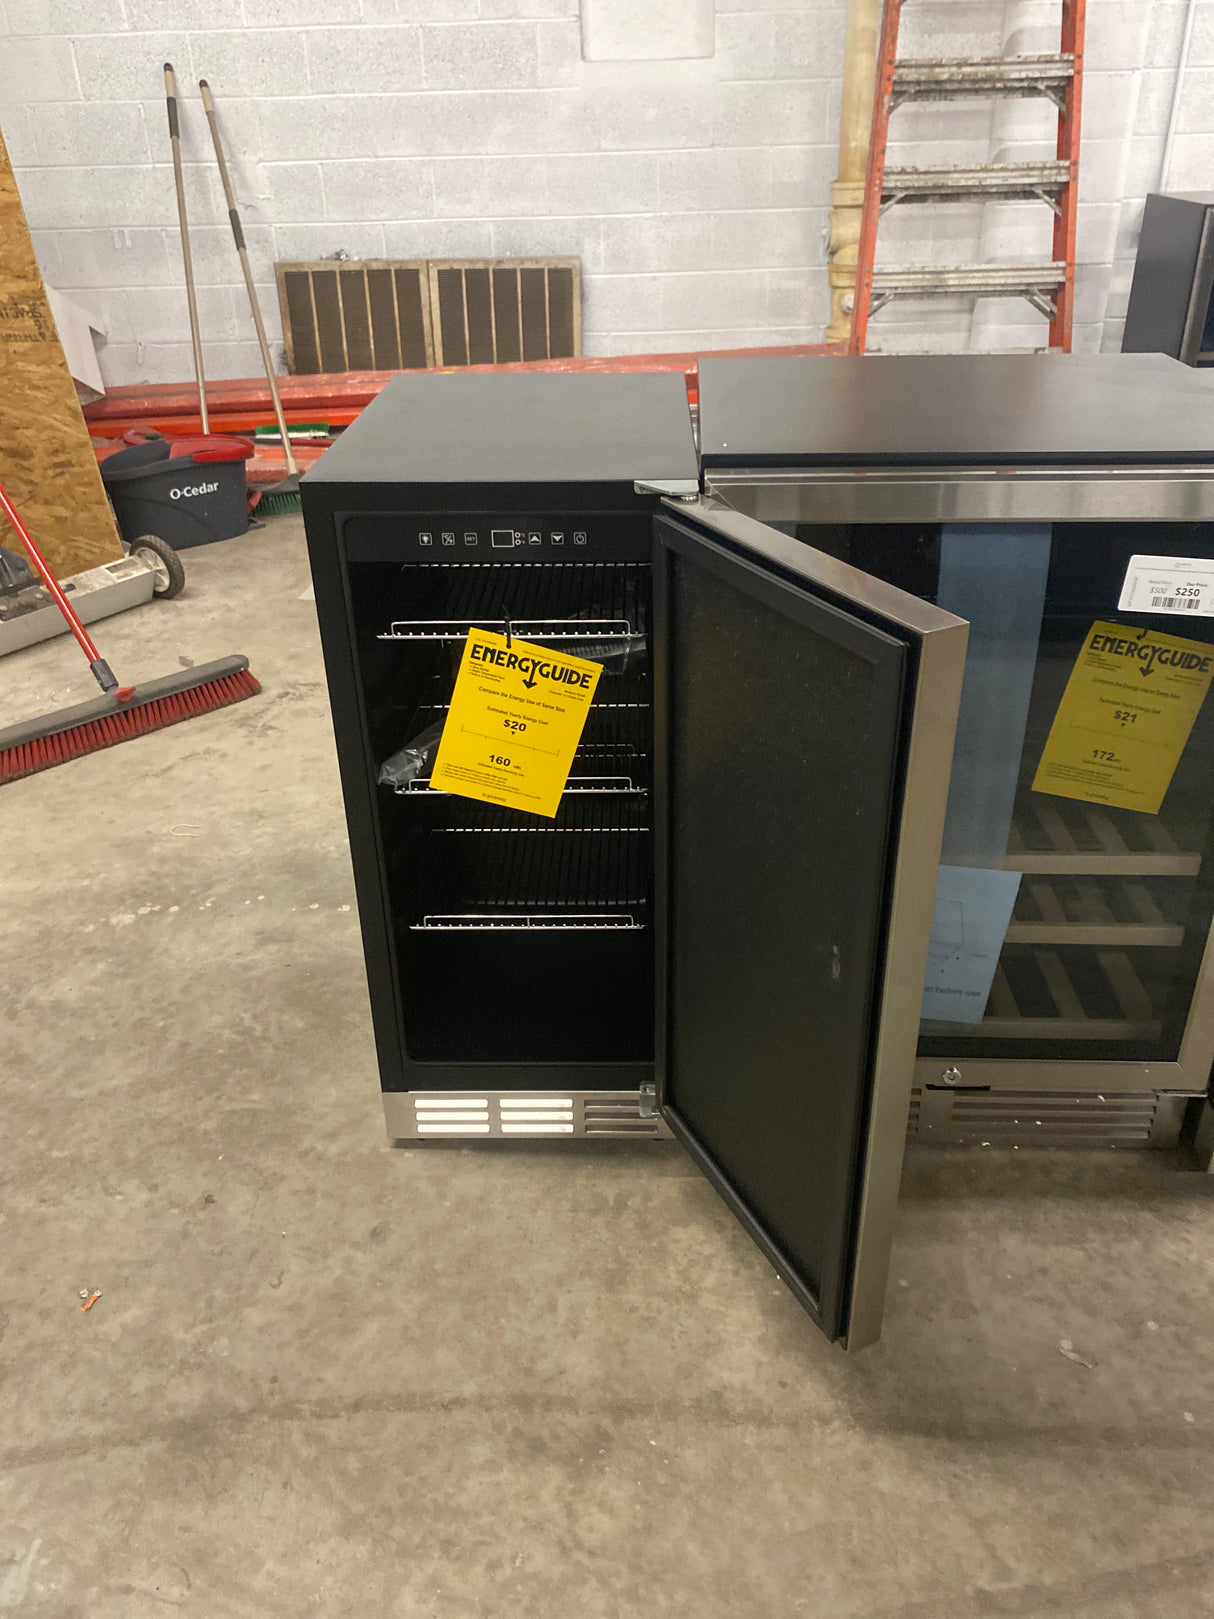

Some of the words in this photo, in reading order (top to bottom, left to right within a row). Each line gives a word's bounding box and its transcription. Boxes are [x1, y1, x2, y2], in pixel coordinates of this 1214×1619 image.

[170, 482, 219, 500] O-Cedar
[1175, 587, 1200, 597] $250
[478, 686, 500, 695] Compare
[509, 694, 525, 703] Energy
[522, 715, 538, 724] Energy
[1114, 710, 1137, 723] $21
[503, 719, 527, 732] $20
[489, 754, 511, 767] 160
[1092, 750, 1115, 761] 172
